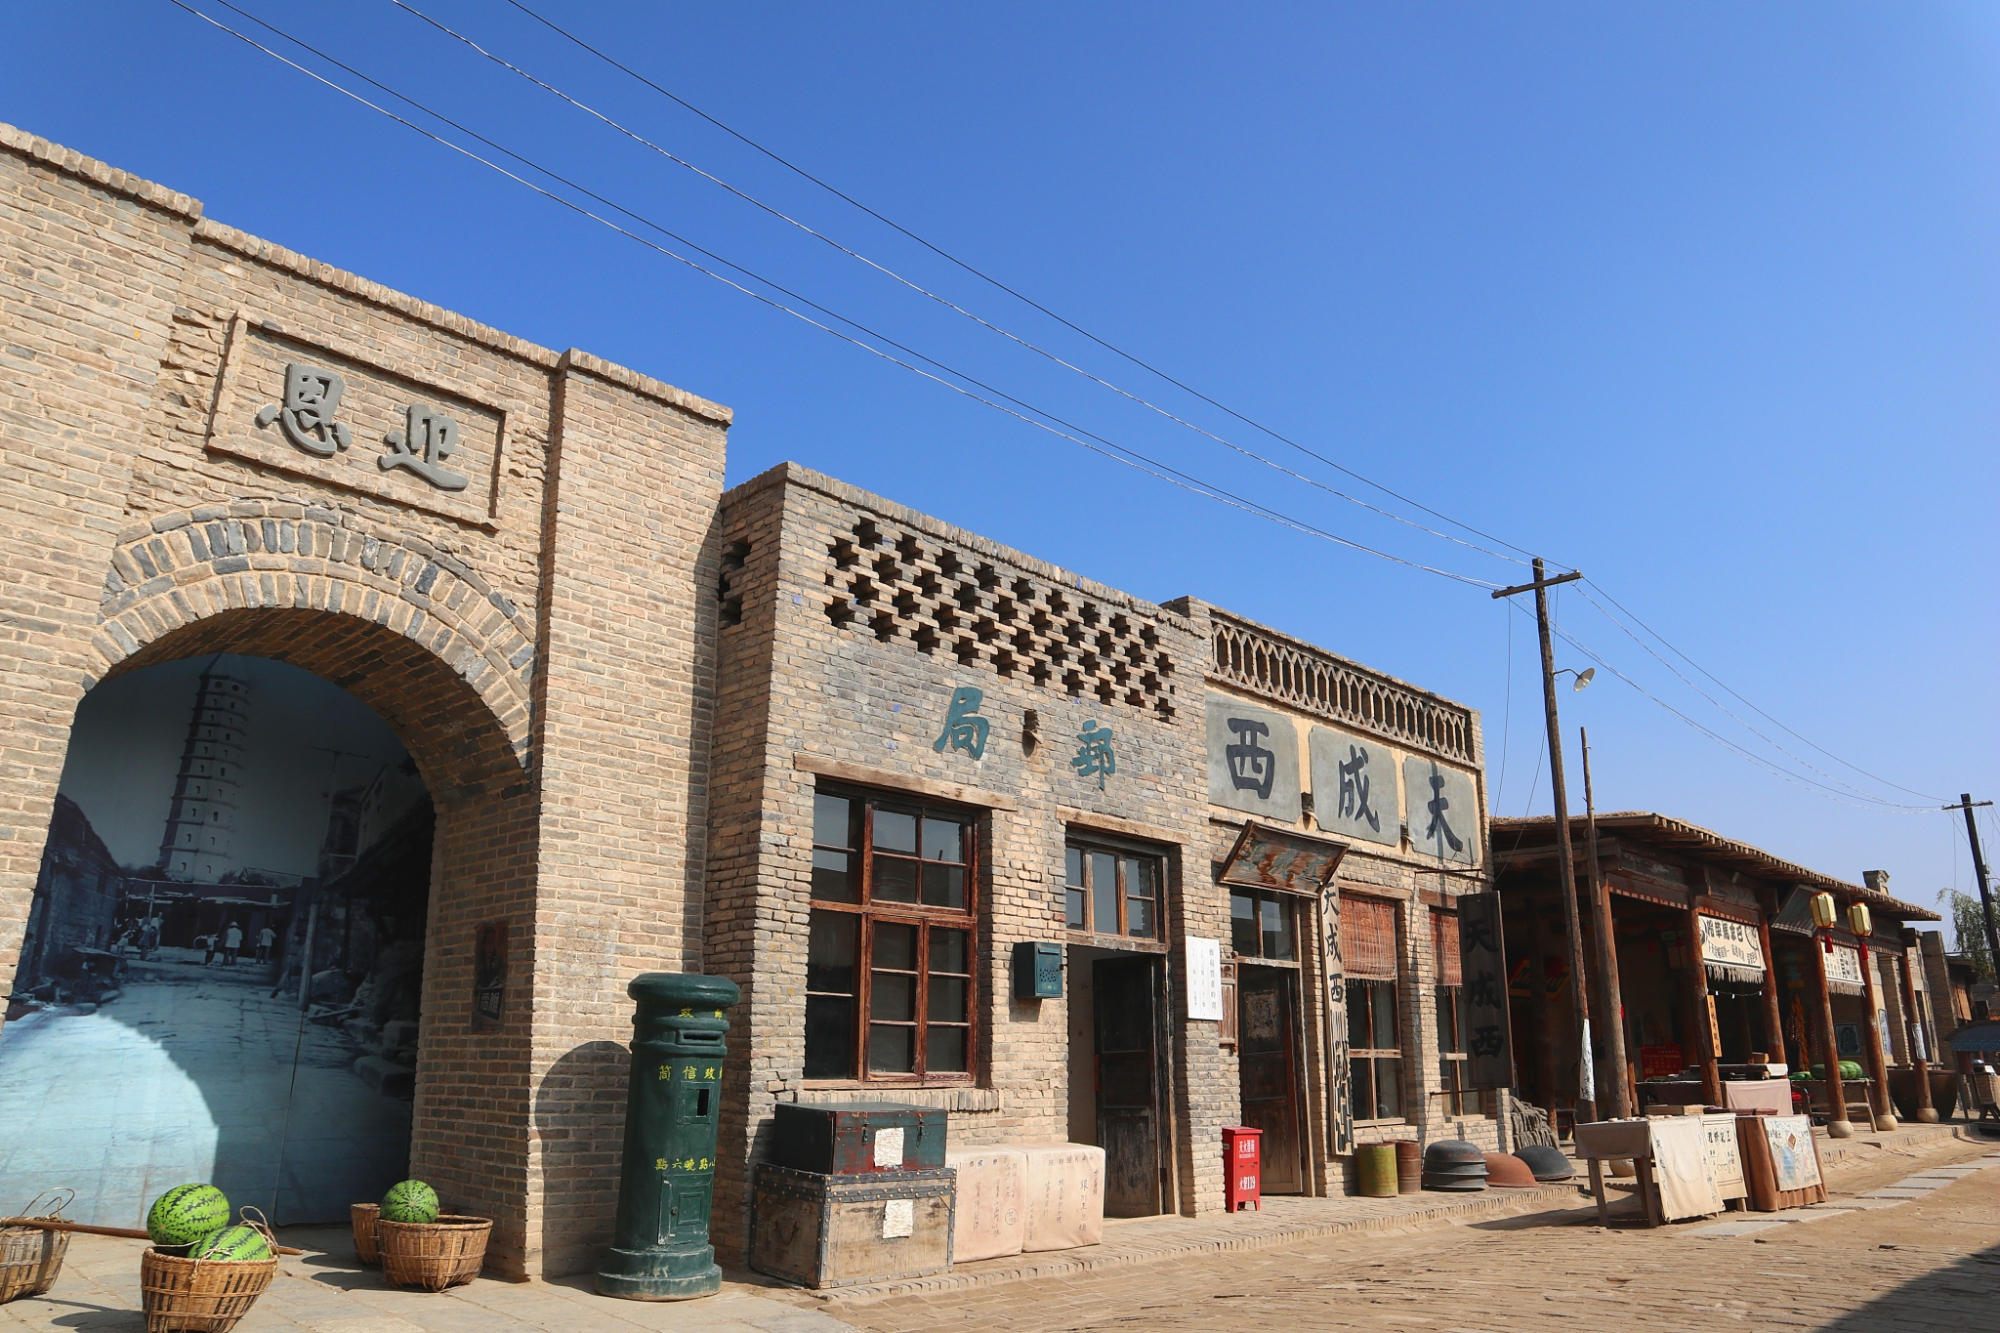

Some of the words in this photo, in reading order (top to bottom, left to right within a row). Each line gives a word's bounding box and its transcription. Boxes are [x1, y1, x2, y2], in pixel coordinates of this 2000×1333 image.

[1323, 882, 1344, 1003] 天成西
[1465, 918, 1504, 1059] 天成西
